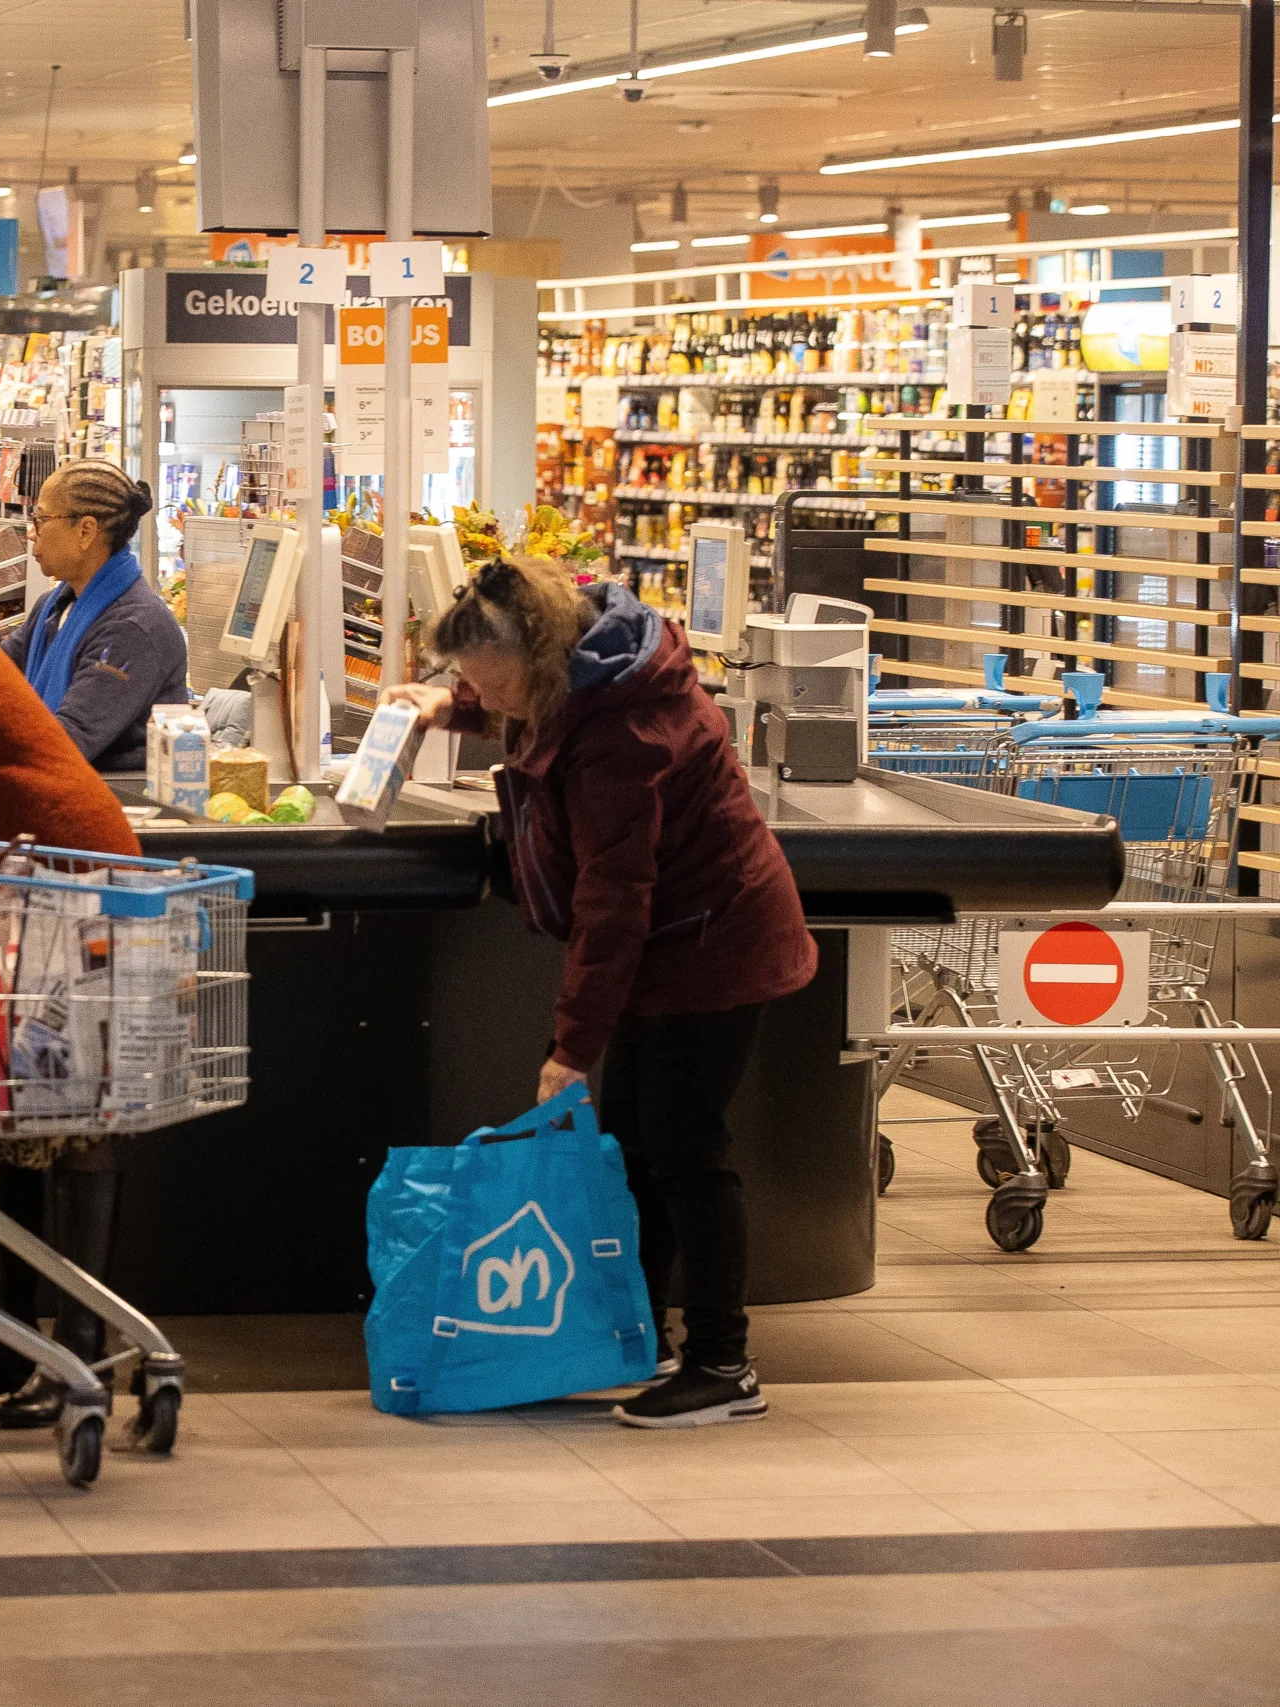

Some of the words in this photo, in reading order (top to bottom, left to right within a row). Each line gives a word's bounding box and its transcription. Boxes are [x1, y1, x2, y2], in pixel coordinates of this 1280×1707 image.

[299, 263, 314, 285] 2
[401, 257, 415, 279] 1
[990, 296, 998, 314] 1
[1179, 290, 1186, 309] 2
[1213, 290, 1222, 309] 2
[347, 324, 441, 347] BOUS
